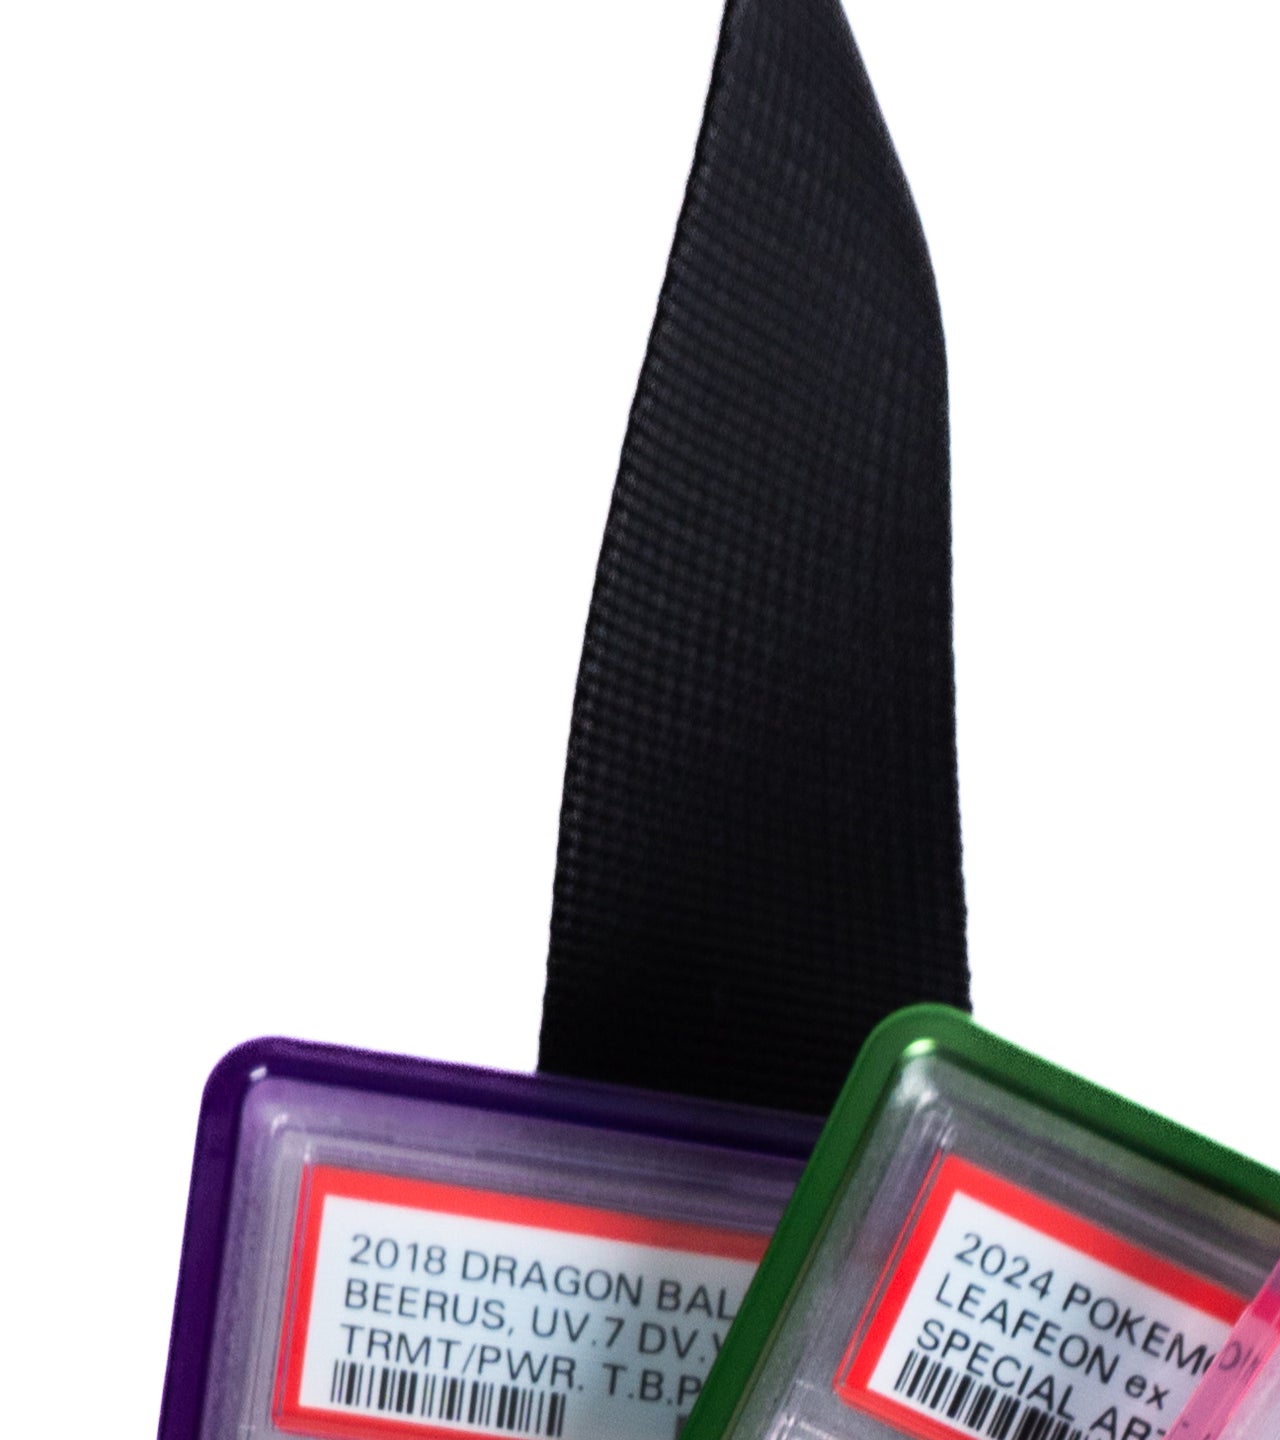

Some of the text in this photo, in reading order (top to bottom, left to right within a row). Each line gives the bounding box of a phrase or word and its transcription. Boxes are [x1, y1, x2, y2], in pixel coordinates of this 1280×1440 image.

[349, 1233, 447, 1276] 2018
[461, 1250, 644, 1309] DRAGON
[954, 1232, 1055, 1301] 2024
[344, 1279, 515, 1337] BEERUS,
[531, 1307, 625, 1348] UV.7
[935, 1273, 1172, 1411] LEAFEON ex
[340, 1324, 584, 1393] TRMT/PWR.
[917, 1318, 1076, 1421] SPECIAL
